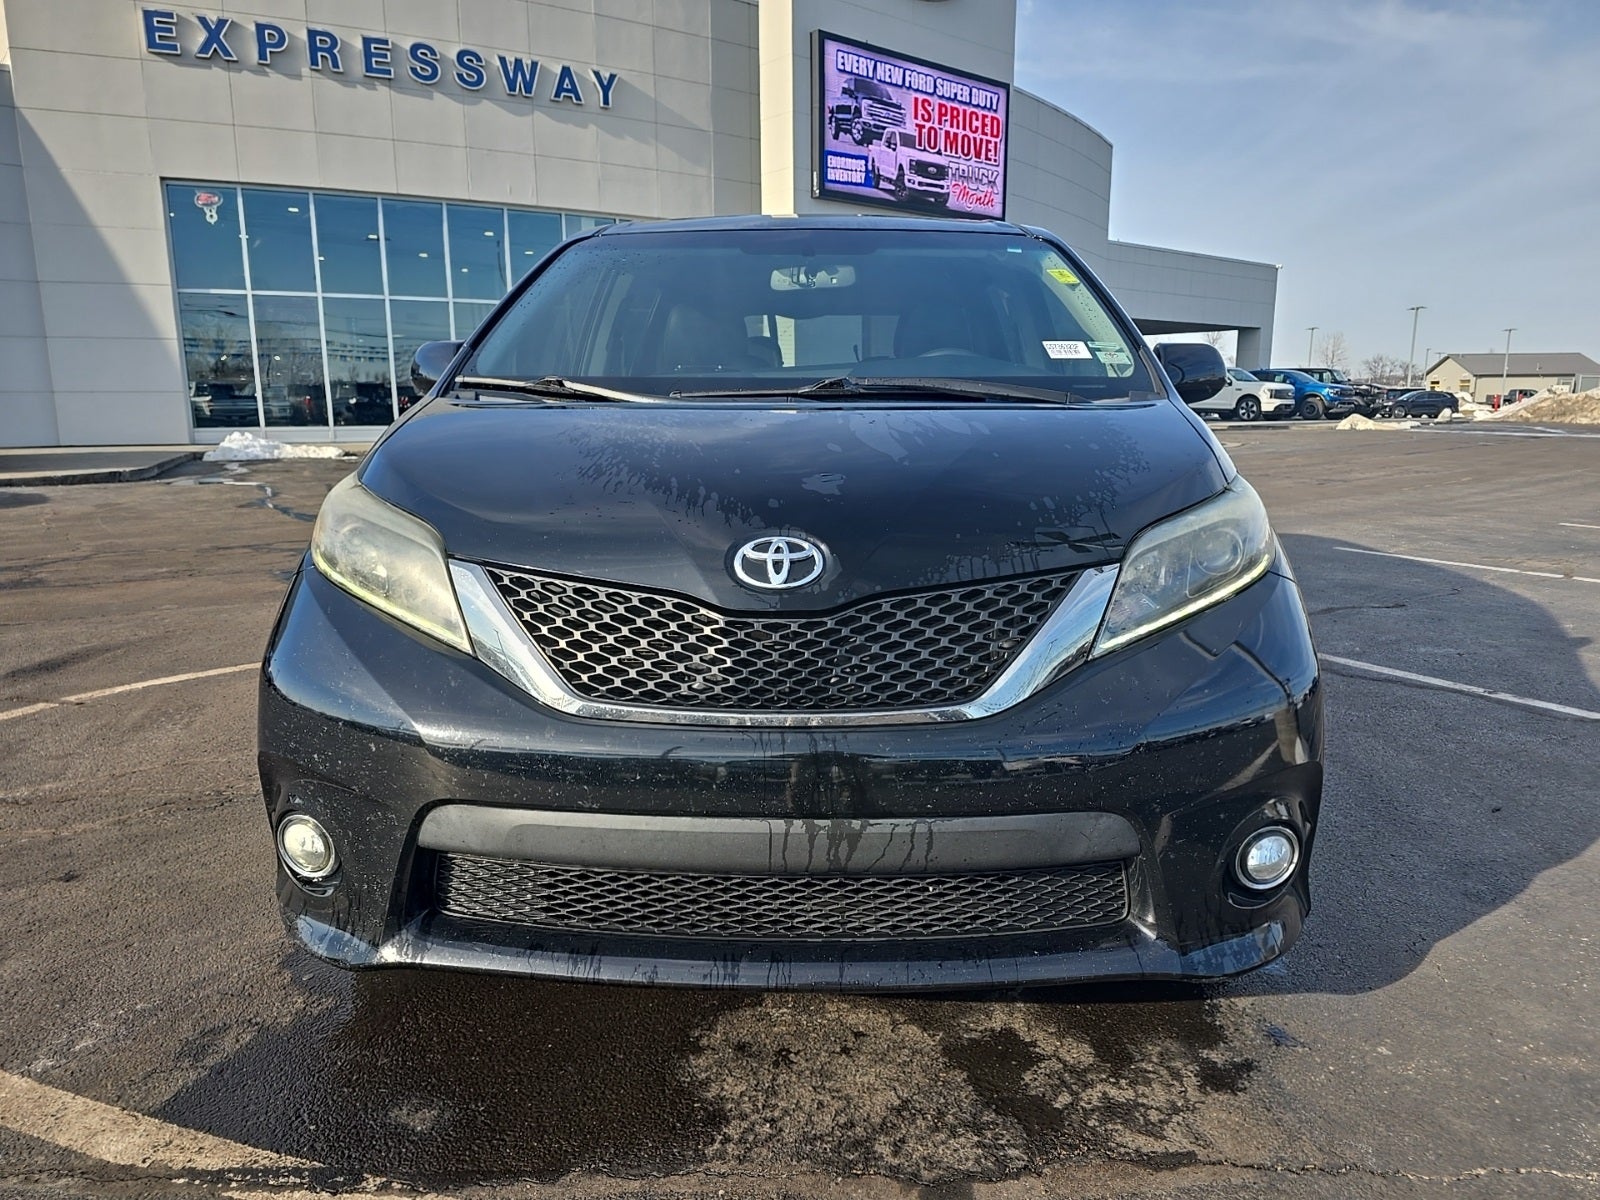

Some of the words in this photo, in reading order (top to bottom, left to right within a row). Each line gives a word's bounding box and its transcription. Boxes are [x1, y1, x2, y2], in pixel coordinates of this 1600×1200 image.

[142, 9, 619, 108] EXPRESSWAY
[837, 51, 875, 78] EVERY
[876, 62, 904, 86] NEW
[904, 70, 934, 94] FORD
[936, 78, 970, 103] SUPER
[971, 87, 999, 109] DUTY
[913, 96, 933, 122] IS
[937, 102, 1001, 139] PRICED
[915, 123, 938, 150] TO
[943, 129, 1000, 163] MOVE!
[948, 161, 999, 194] TRUCK
[952, 183, 995, 209] Month
